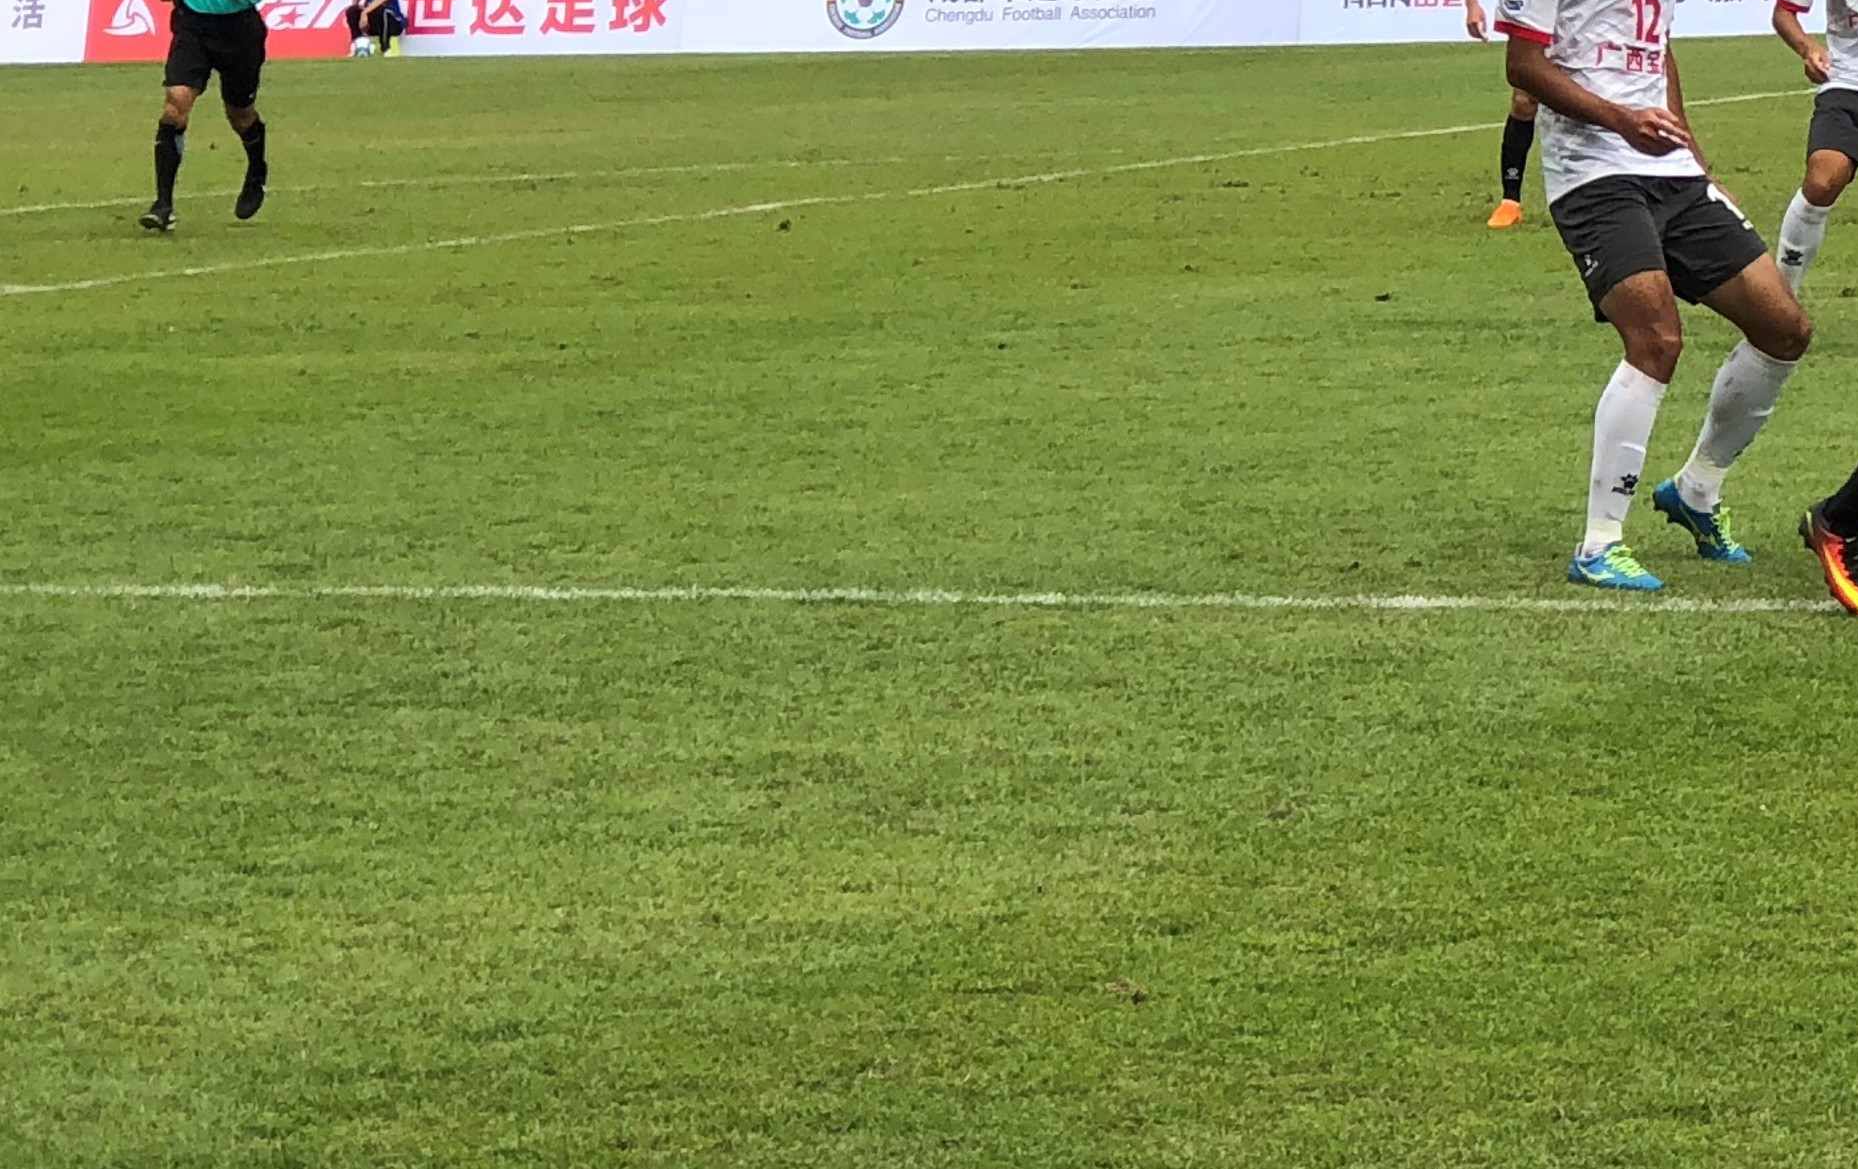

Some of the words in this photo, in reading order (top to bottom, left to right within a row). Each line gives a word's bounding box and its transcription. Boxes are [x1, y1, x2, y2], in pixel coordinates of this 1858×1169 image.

[925, 7, 993, 26] Chengdu
[1002, 6, 1061, 21] Football
[1070, 5, 1156, 21] Association
